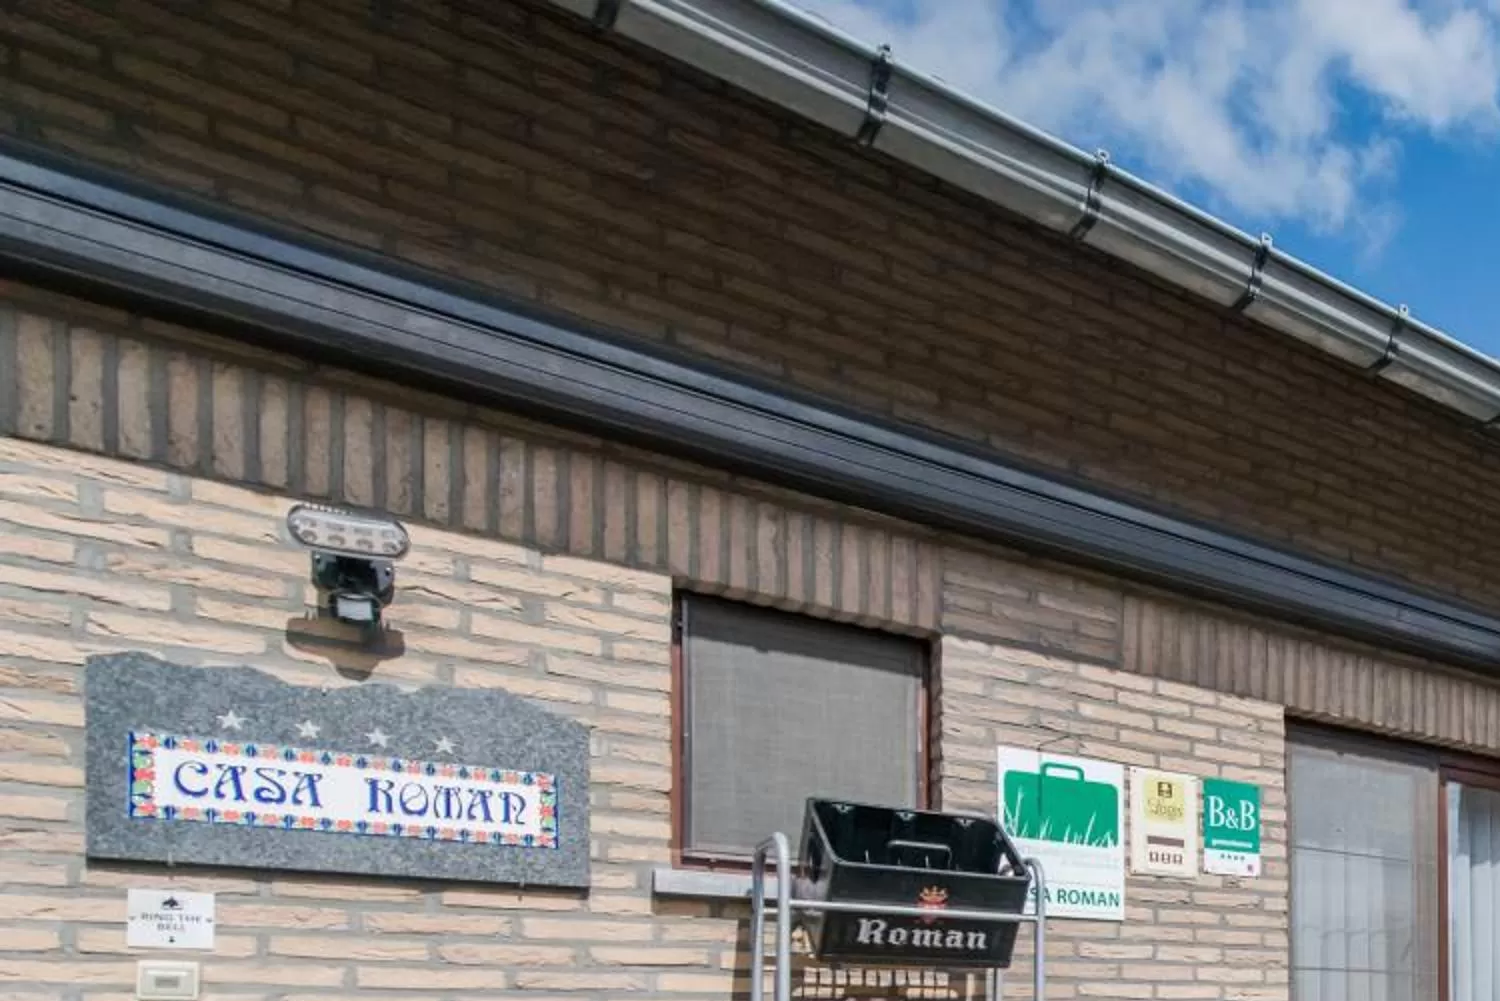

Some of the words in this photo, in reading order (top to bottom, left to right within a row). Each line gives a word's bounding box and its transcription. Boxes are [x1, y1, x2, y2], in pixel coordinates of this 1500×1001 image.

[173, 759, 324, 808] CASA
[364, 776, 527, 826] ROMAN
[1208, 795, 1256, 831] B&B
[1057, 887, 1120, 908] ROMAN
[856, 918, 988, 950] Roman
